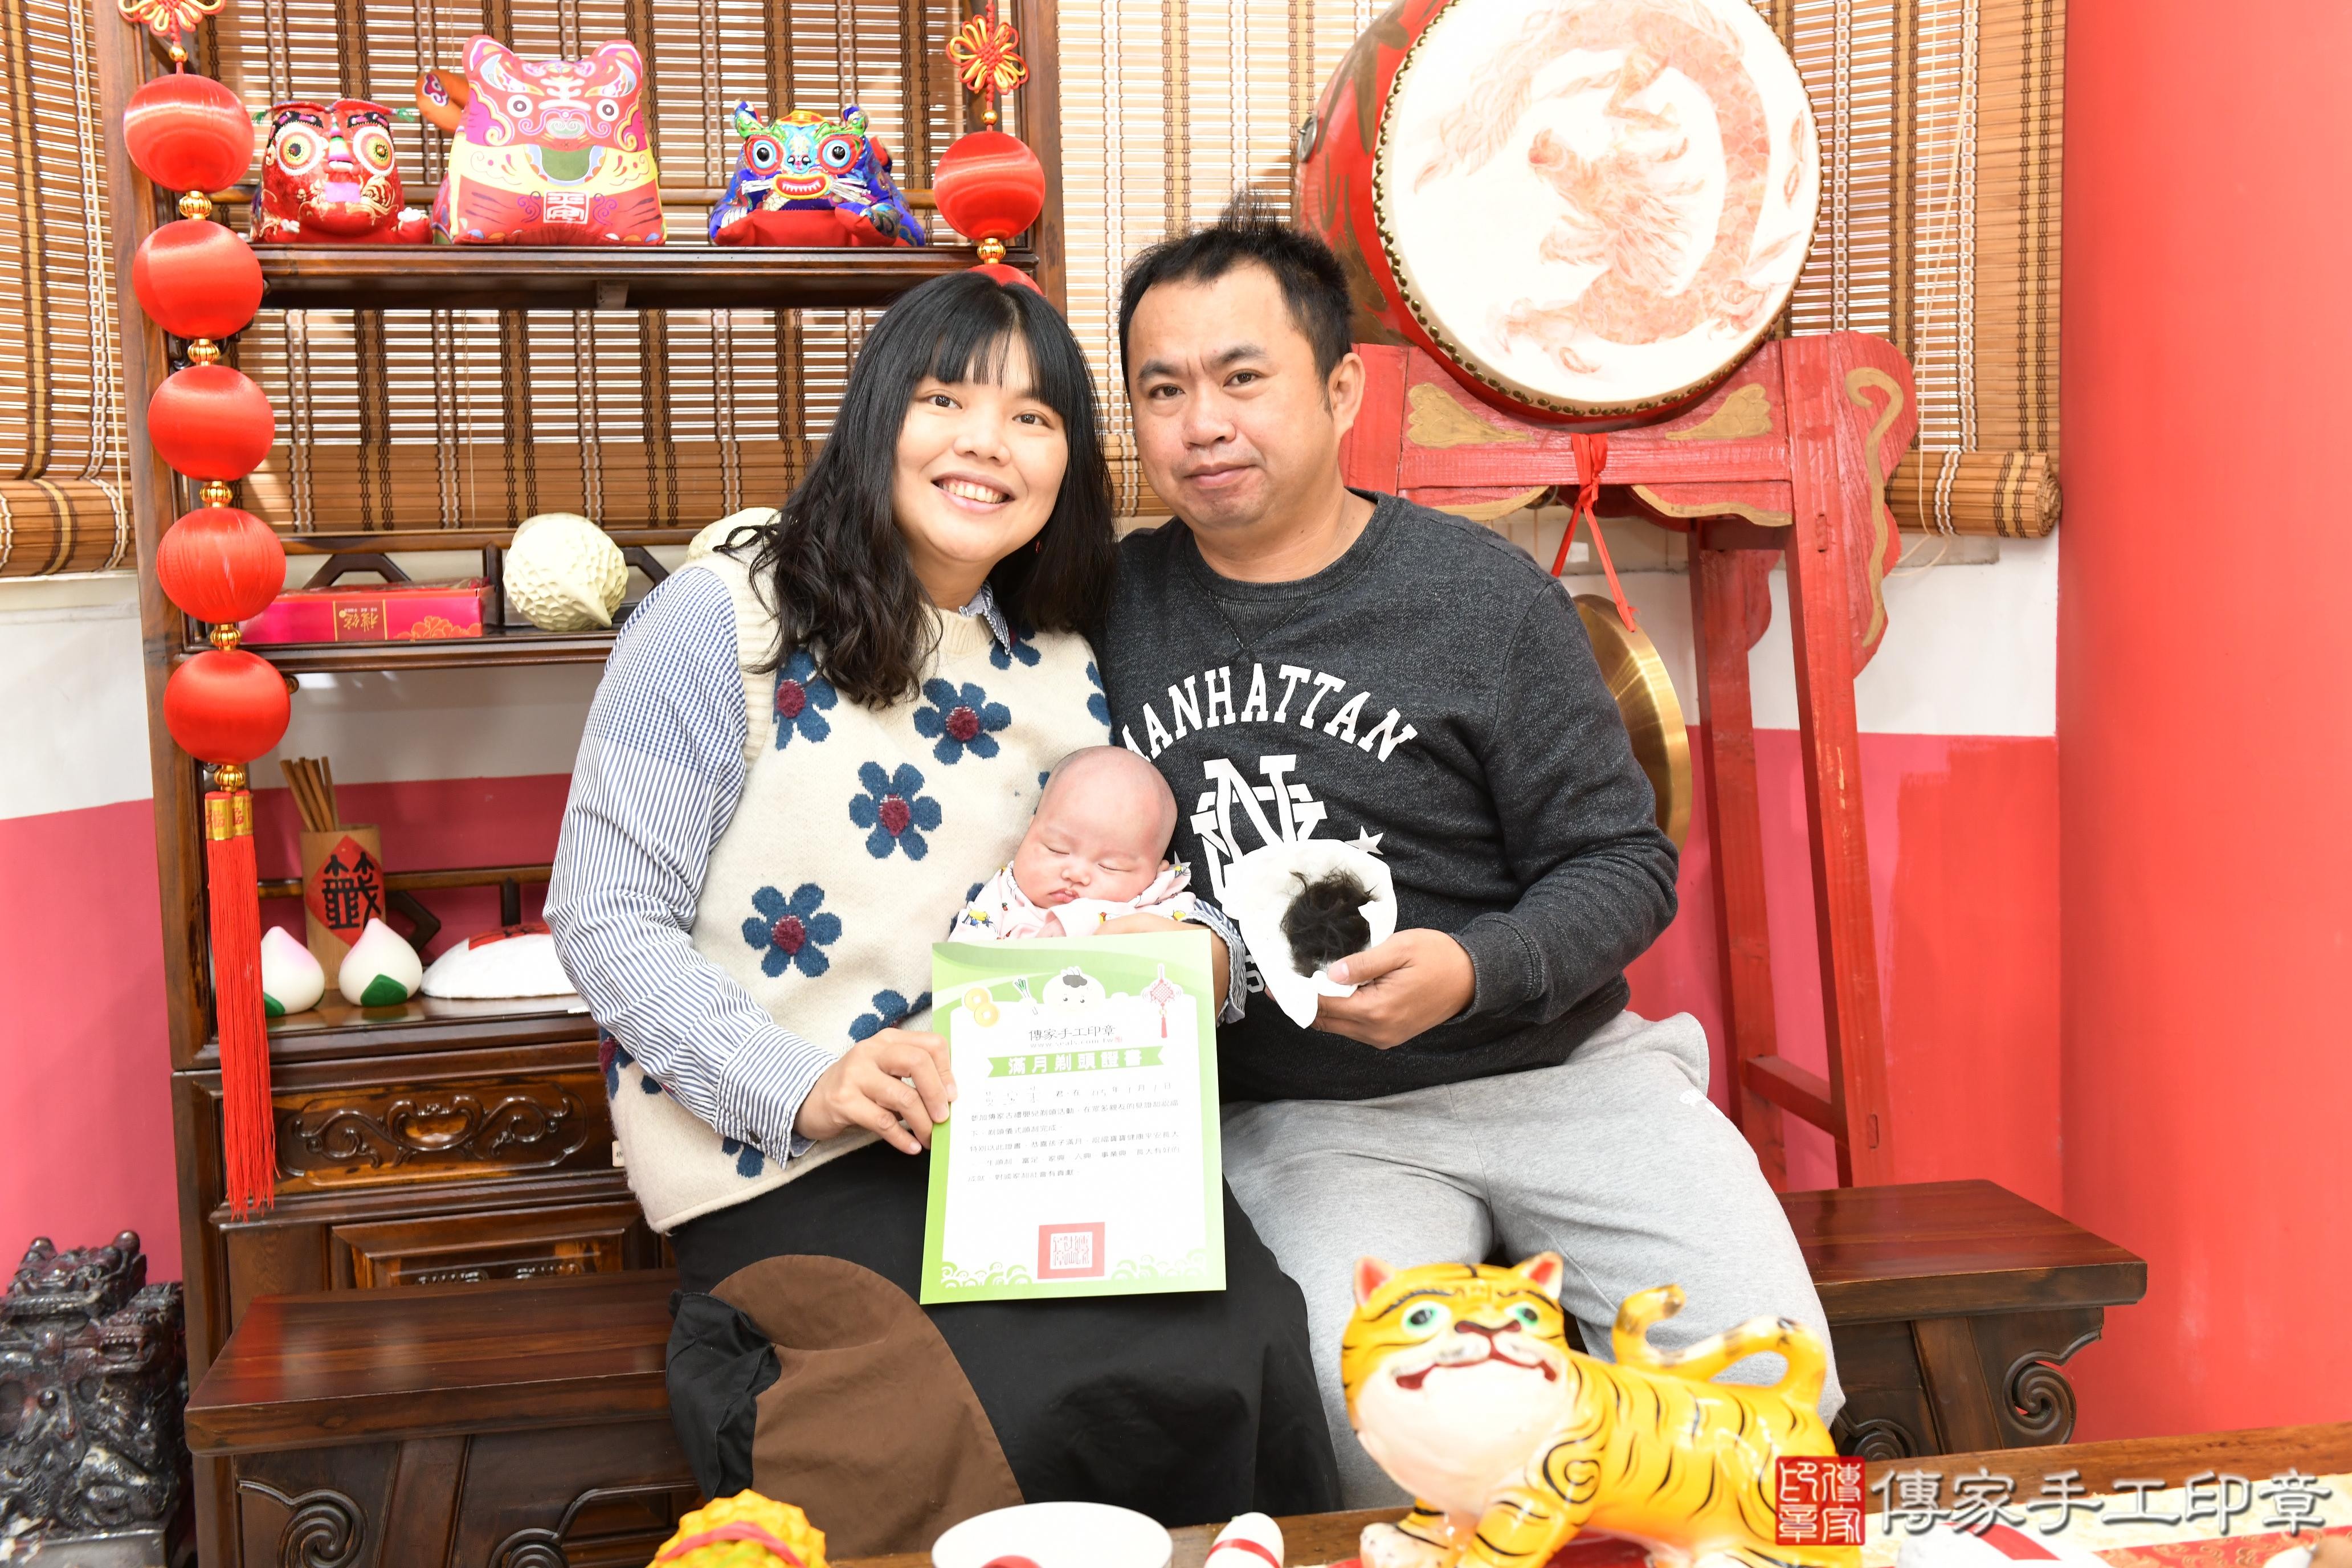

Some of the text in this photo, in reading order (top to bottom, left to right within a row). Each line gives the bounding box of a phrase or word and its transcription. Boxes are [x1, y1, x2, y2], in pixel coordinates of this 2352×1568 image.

[1029, 1024, 1116, 1042] 傳家手工印章
[1008, 1049, 1142, 1076] 滿月剃頭證書
